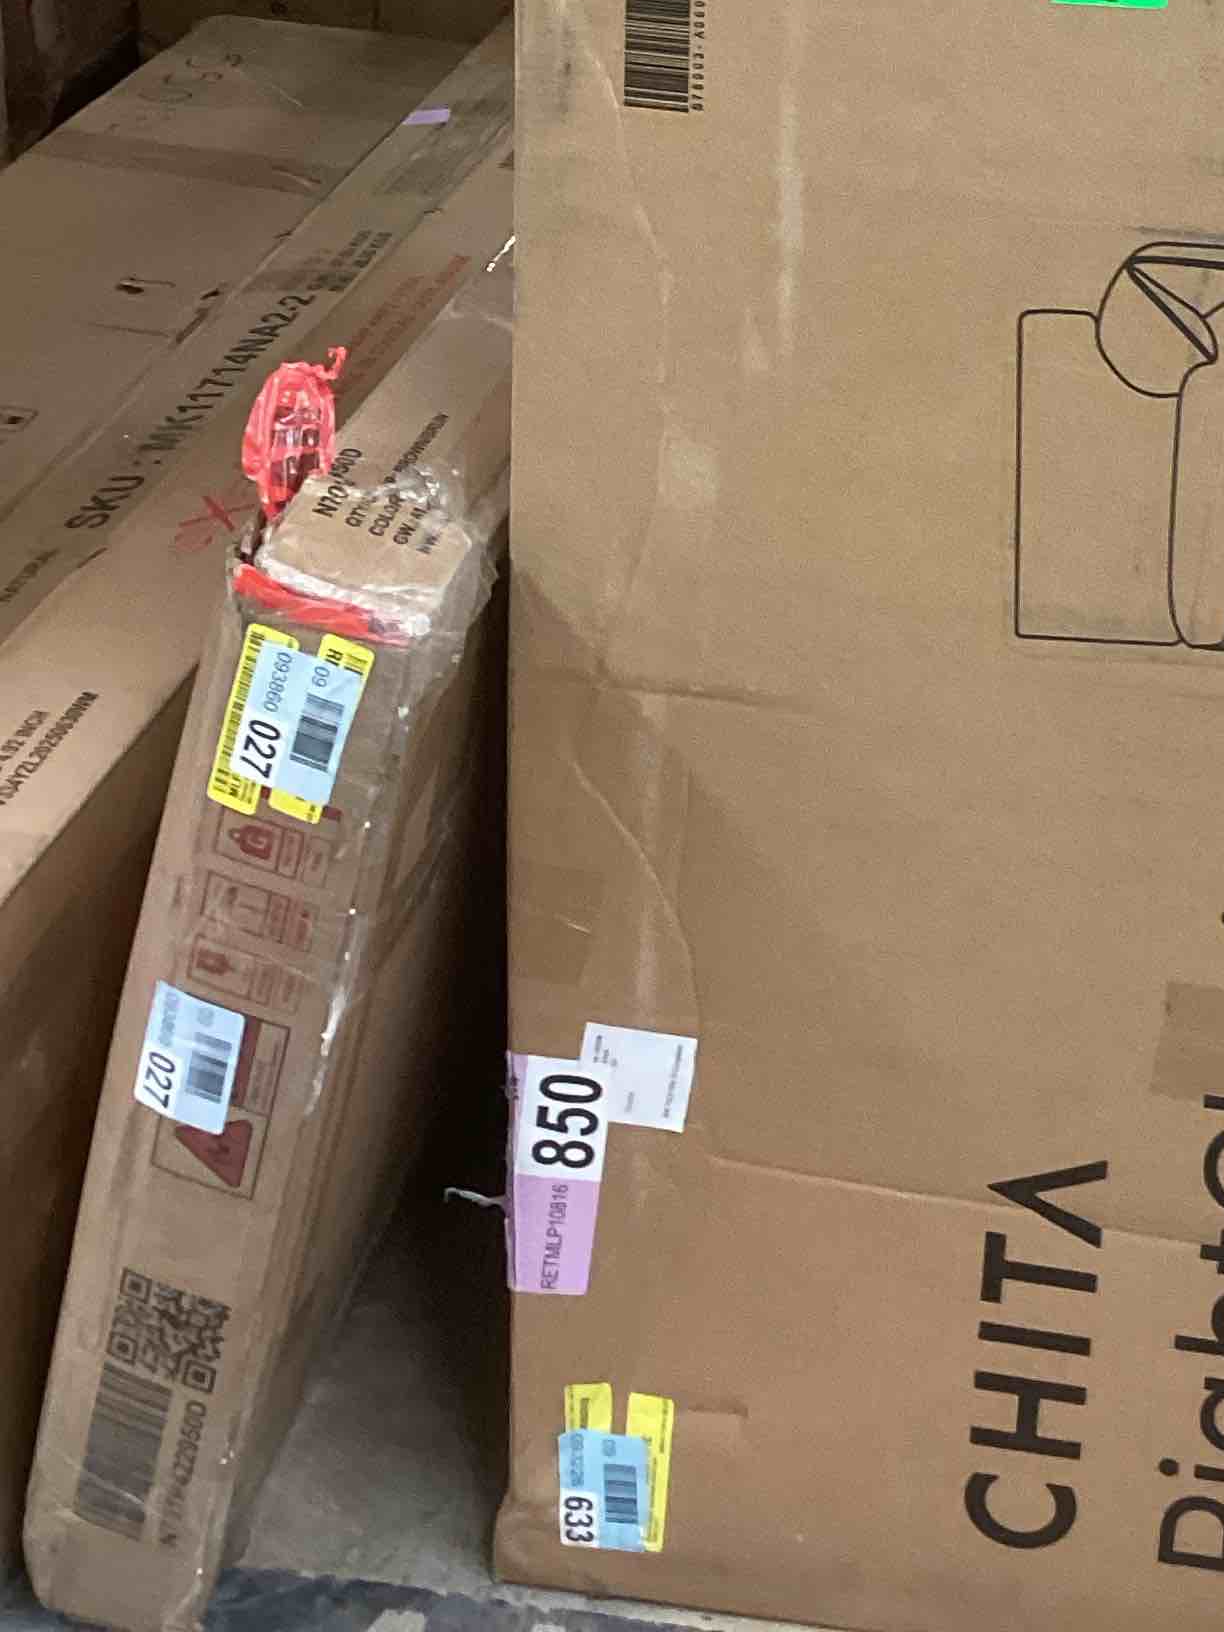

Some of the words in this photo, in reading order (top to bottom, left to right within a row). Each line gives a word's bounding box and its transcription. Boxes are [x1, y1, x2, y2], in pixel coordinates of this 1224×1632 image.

[240, 719, 281, 779] 027
[143, 1051, 176, 1109] 027
[531, 1073, 604, 1170] 850
[963, 1159, 1109, 1550] CHITA
[563, 1495, 595, 1544] 633
